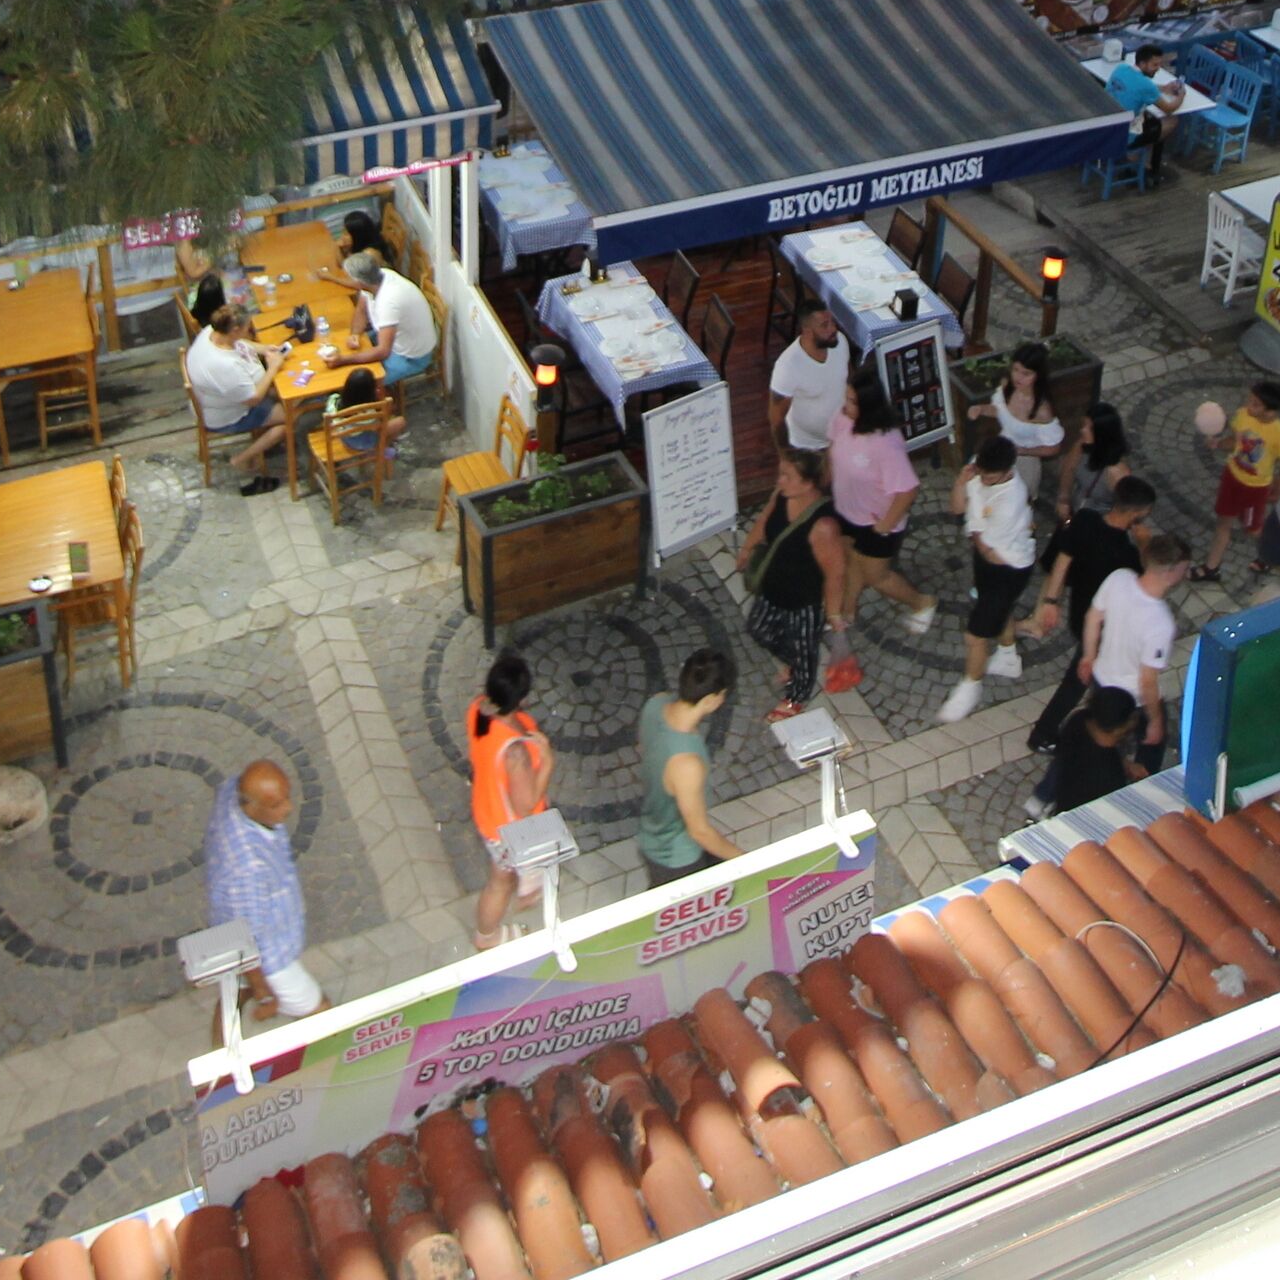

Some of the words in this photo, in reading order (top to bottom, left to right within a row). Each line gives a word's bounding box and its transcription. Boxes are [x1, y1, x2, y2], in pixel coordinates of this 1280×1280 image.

[768, 181, 863, 222] BEYOĞLU
[869, 156, 984, 203] MEYHANESİ
[659, 886, 730, 928] SELF
[356, 1014, 402, 1041] SELF
[452, 1016, 540, 1050] KAVUN
[545, 993, 630, 1034] İÇİNDE
[419, 1061, 435, 1081] 5
[443, 1051, 496, 1077] TOP
[501, 1017, 641, 1064] DONDURMA
[226, 1087, 303, 1137] ARASI
